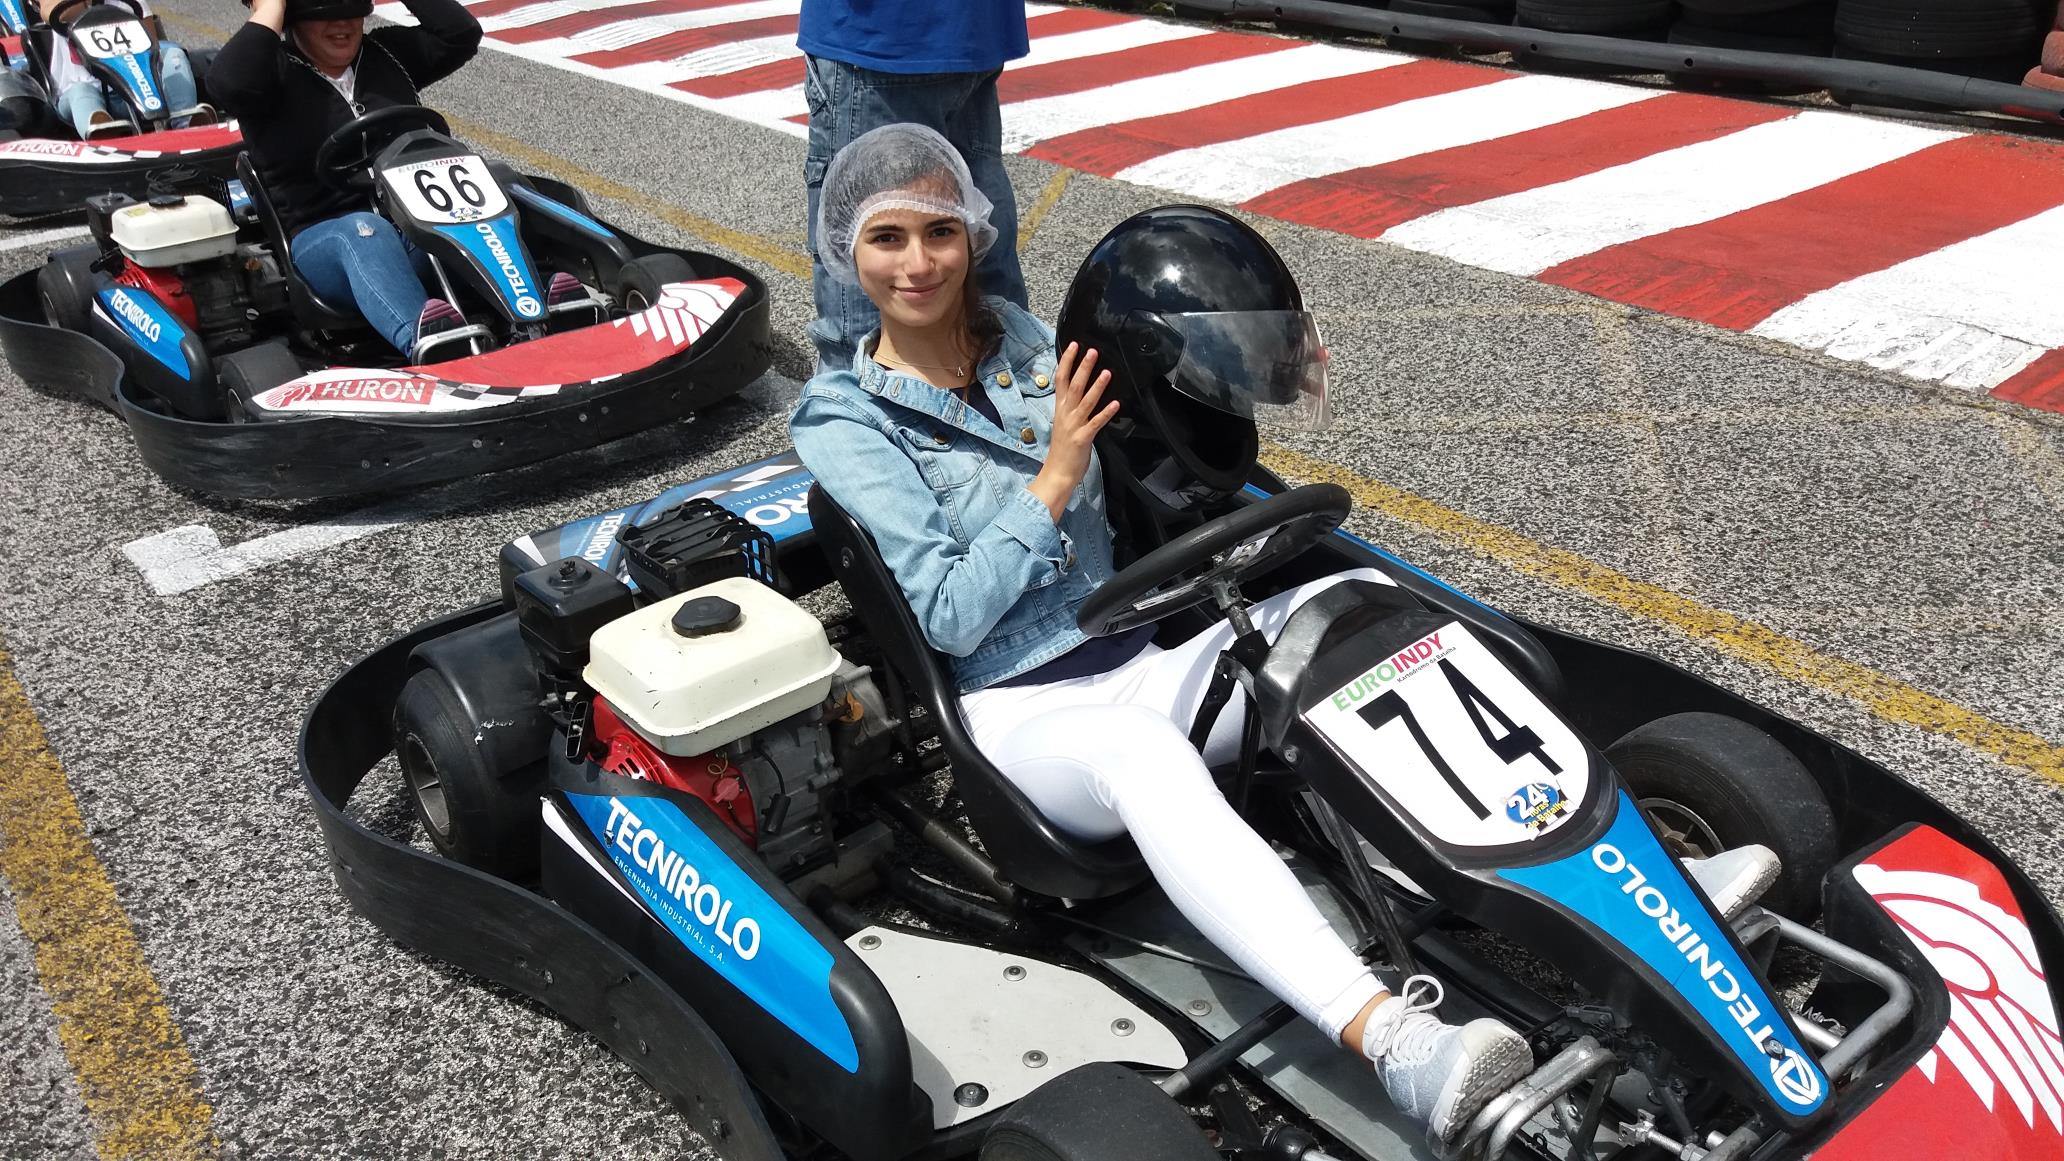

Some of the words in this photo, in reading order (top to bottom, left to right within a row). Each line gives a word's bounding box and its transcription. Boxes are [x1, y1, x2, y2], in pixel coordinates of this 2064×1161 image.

[90, 27, 132, 52] 64
[18, 143, 80, 156] HURON
[413, 164, 486, 213] 66
[475, 223, 529, 297] TECNIROLO
[111, 288, 161, 343] TECNIROLO
[321, 380, 426, 401] HURON
[583, 513, 625, 567] TECNIROL
[1331, 632, 1443, 712] EUROINDY
[1355, 657, 1564, 822] 74
[603, 797, 761, 961] TECNIROLO
[614, 856, 658, 902] ENGENHARIA
[659, 899, 706, 948] INDUSTRIAL,
[1592, 843, 1774, 1055] TECNIROLO
